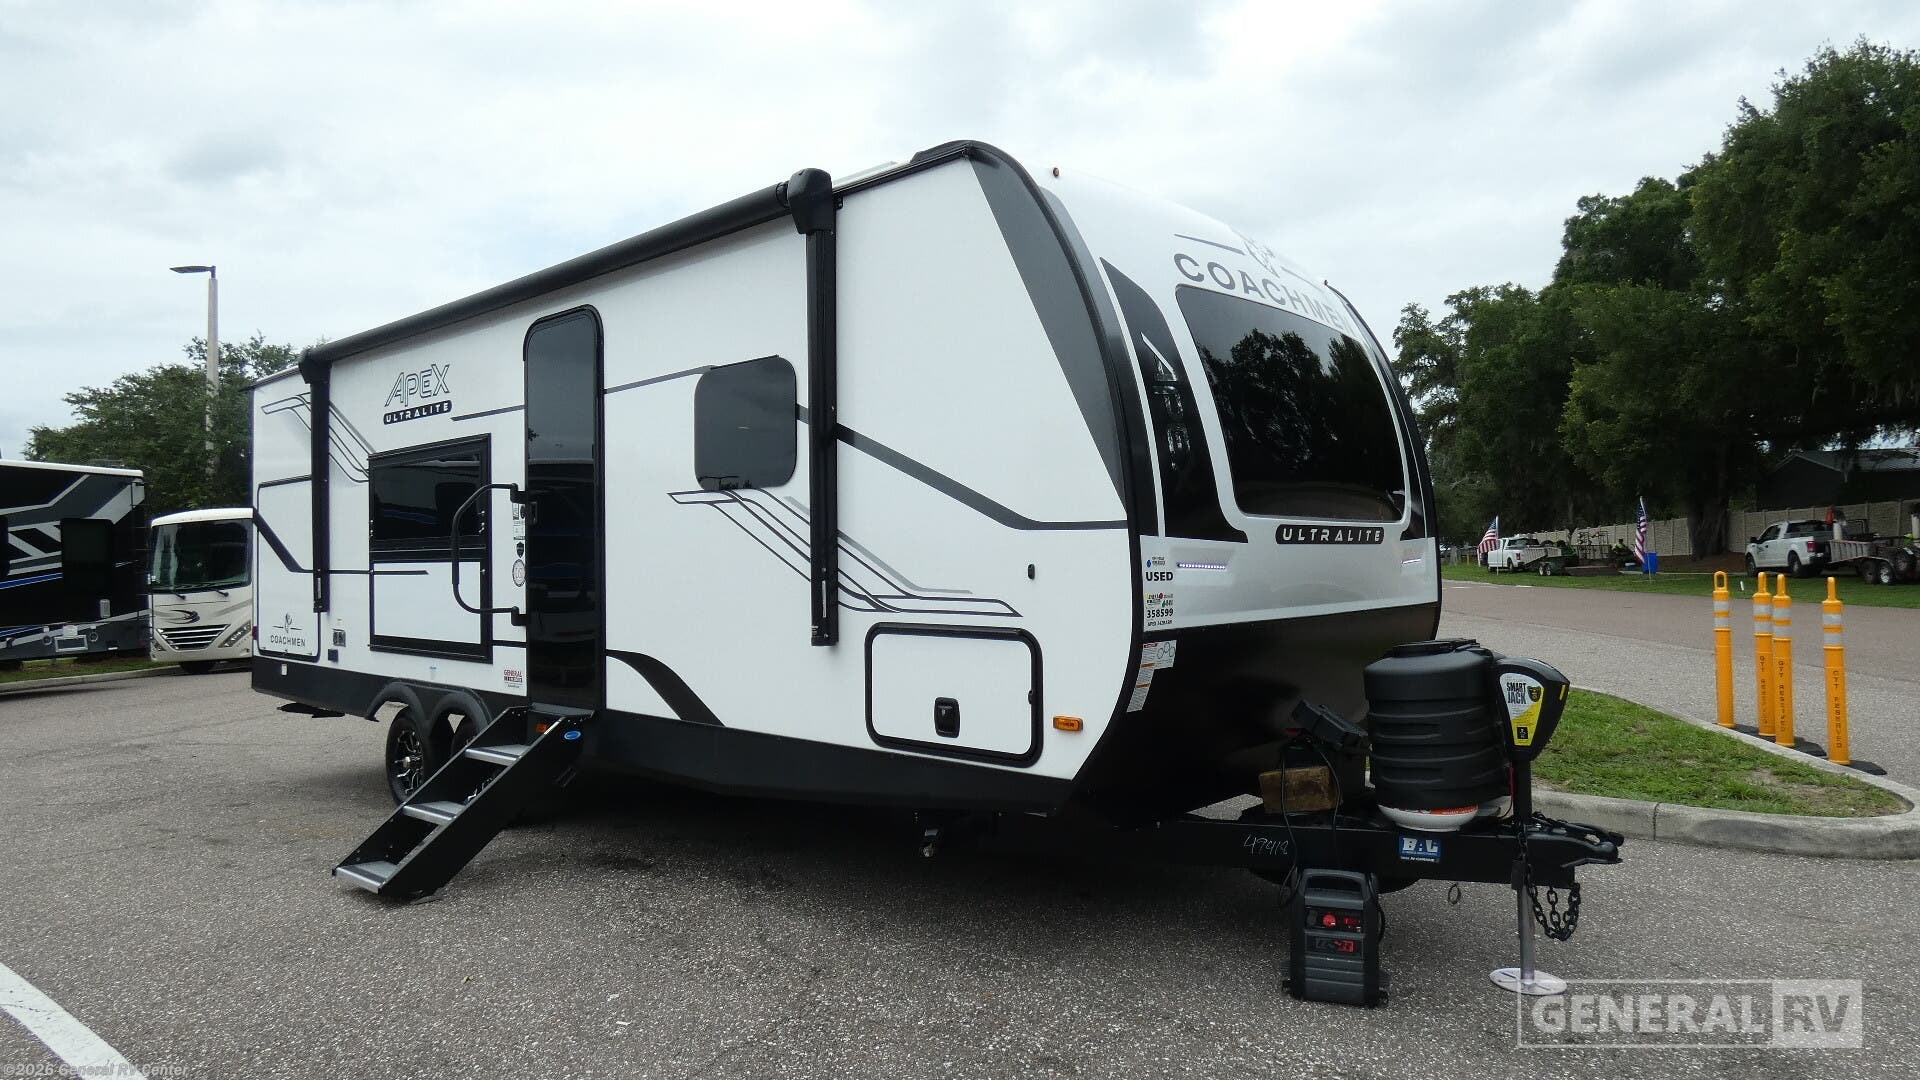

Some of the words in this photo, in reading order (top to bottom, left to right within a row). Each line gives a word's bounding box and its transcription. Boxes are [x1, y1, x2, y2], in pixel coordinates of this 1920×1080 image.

[1174, 253, 1358, 338] COACHMEN
[384, 364, 450, 407] APEX
[386, 402, 449, 423] ULTRALITE
[1282, 528, 1381, 542] ULTRALITE
[1145, 571, 1174, 582] USED
[1146, 608, 1174, 619] 358599
[270, 634, 306, 647] COACHMEN
[1506, 682, 1527, 693] SMART
[1507, 691, 1527, 705] JACK
